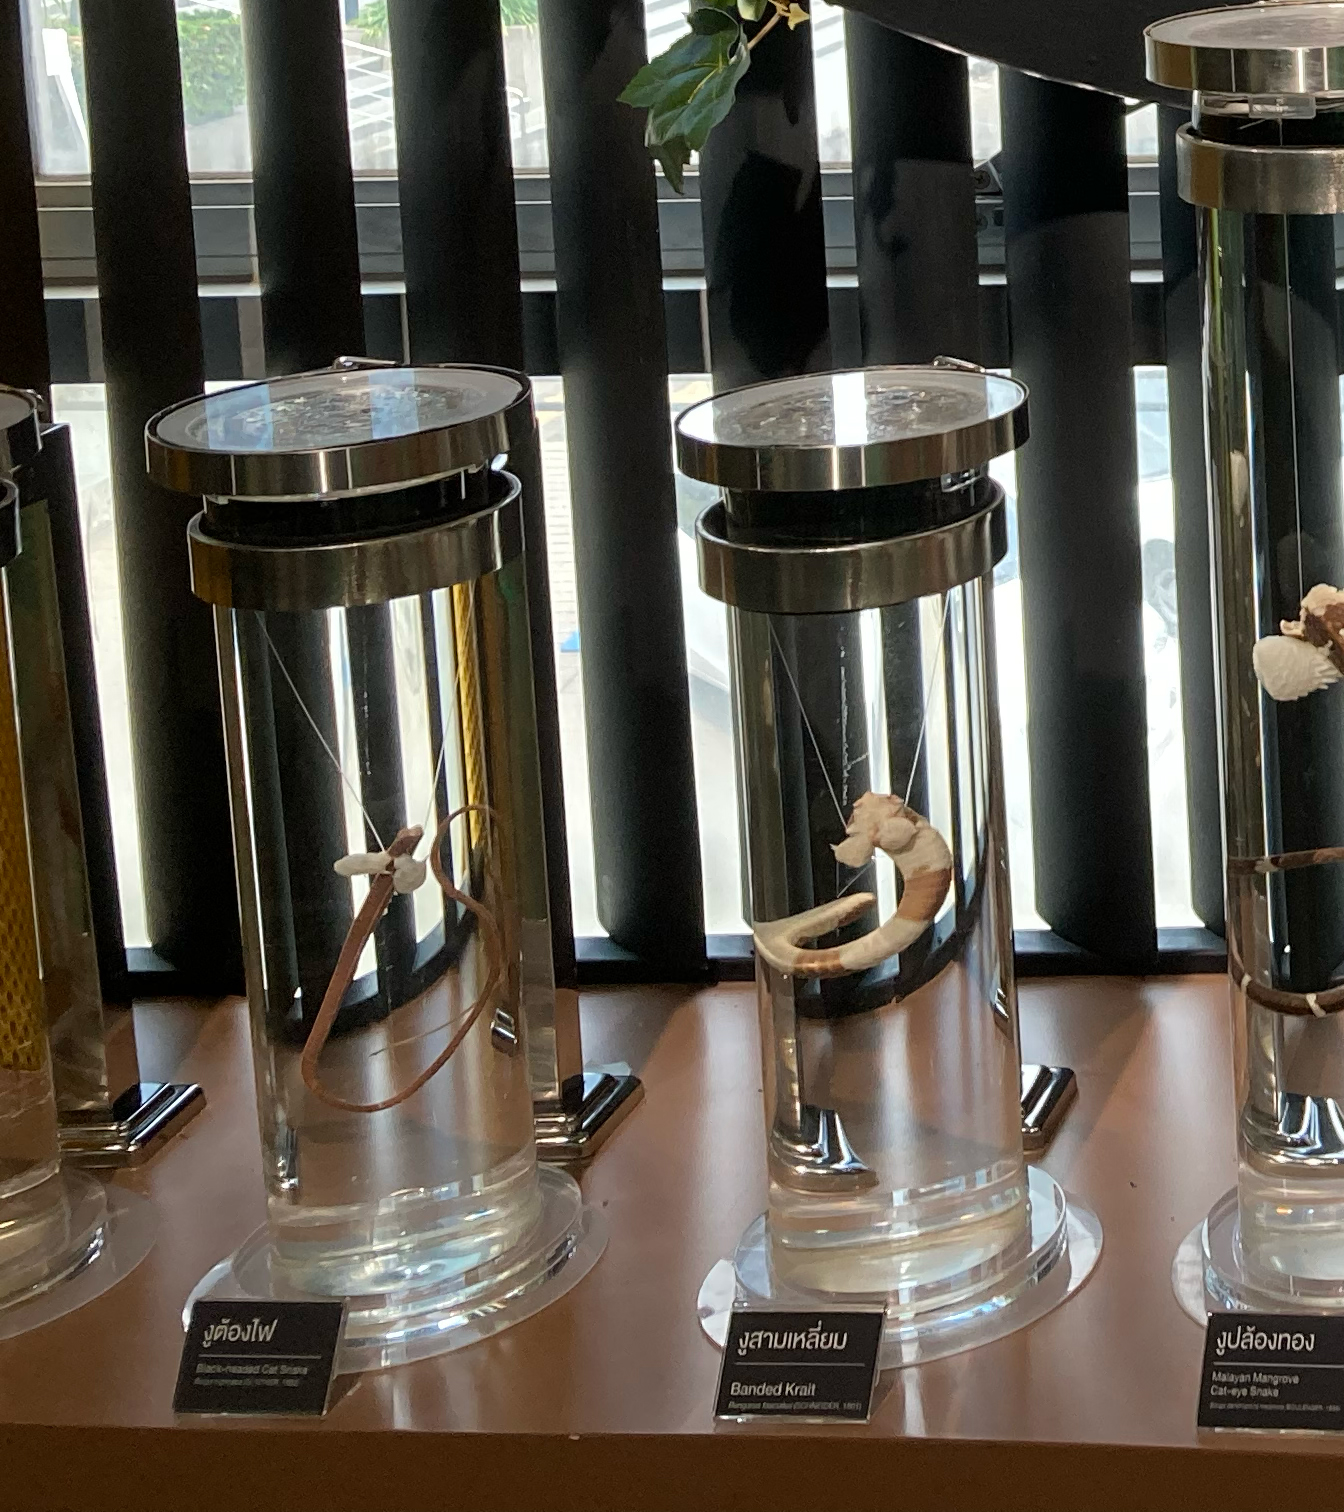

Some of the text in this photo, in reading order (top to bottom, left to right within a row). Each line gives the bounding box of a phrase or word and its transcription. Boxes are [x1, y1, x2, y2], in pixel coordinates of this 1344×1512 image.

[202, 1318, 278, 1348] งูต้องไฟ
[737, 1320, 847, 1356] งูสามเหลี่ยม
[1215, 1325, 1316, 1356] งูปล้องทอง
[730, 1381, 816, 1396] Banded Krait
[1212, 1371, 1300, 1385] Malayan Mangrove
[1210, 1385, 1279, 1398] Cat-eye Snake
